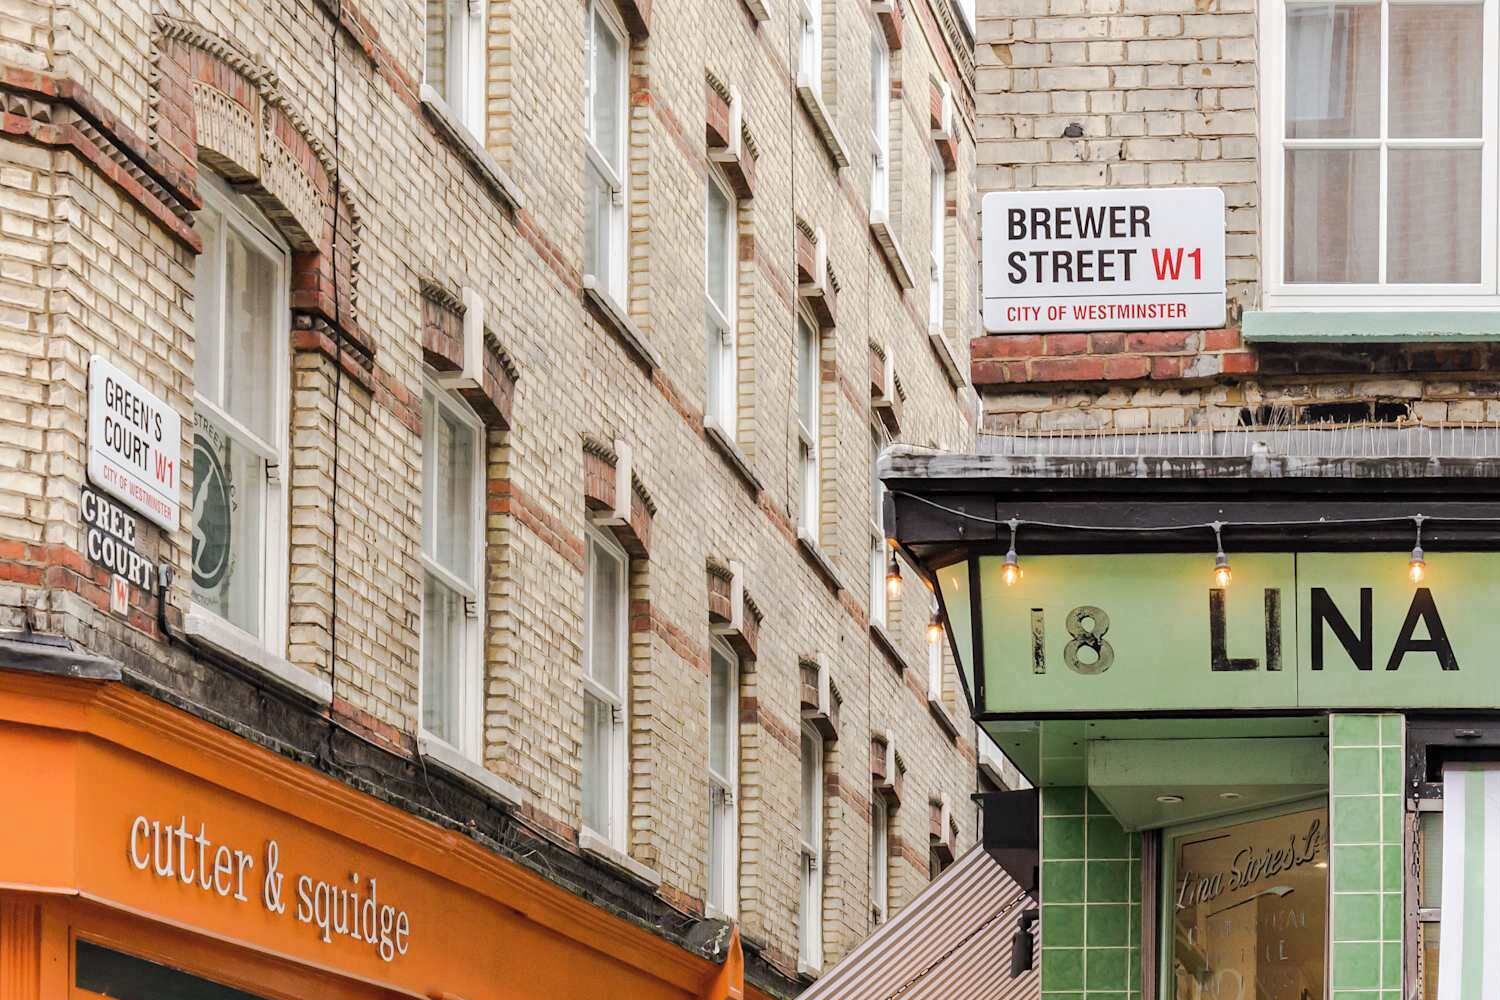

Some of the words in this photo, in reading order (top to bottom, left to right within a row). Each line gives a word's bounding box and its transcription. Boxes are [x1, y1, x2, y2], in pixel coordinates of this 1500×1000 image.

[1007, 205, 1151, 241] BREWER
[1007, 248, 1137, 284] STREET
[1151, 247, 1203, 281] W1
[1007, 305, 1041, 321] CITY
[1047, 304, 1068, 321] OF
[1073, 303, 1187, 320] WESTMINSTER
[105, 377, 162, 442] GREEN'S
[105, 415, 149, 471] COURT
[155, 448, 173, 488] W1
[103, 464, 117, 487] CITY
[120, 475, 128, 491] OF
[130, 480, 172, 521] WESTMINSTER
[88, 528, 153, 591] COURT
[1030, 606, 1114, 675] 18
[1209, 587, 1460, 672] LINA
[130, 815, 254, 902] cutter
[263, 840, 286, 915] &
[297, 872, 411, 962] squidge
